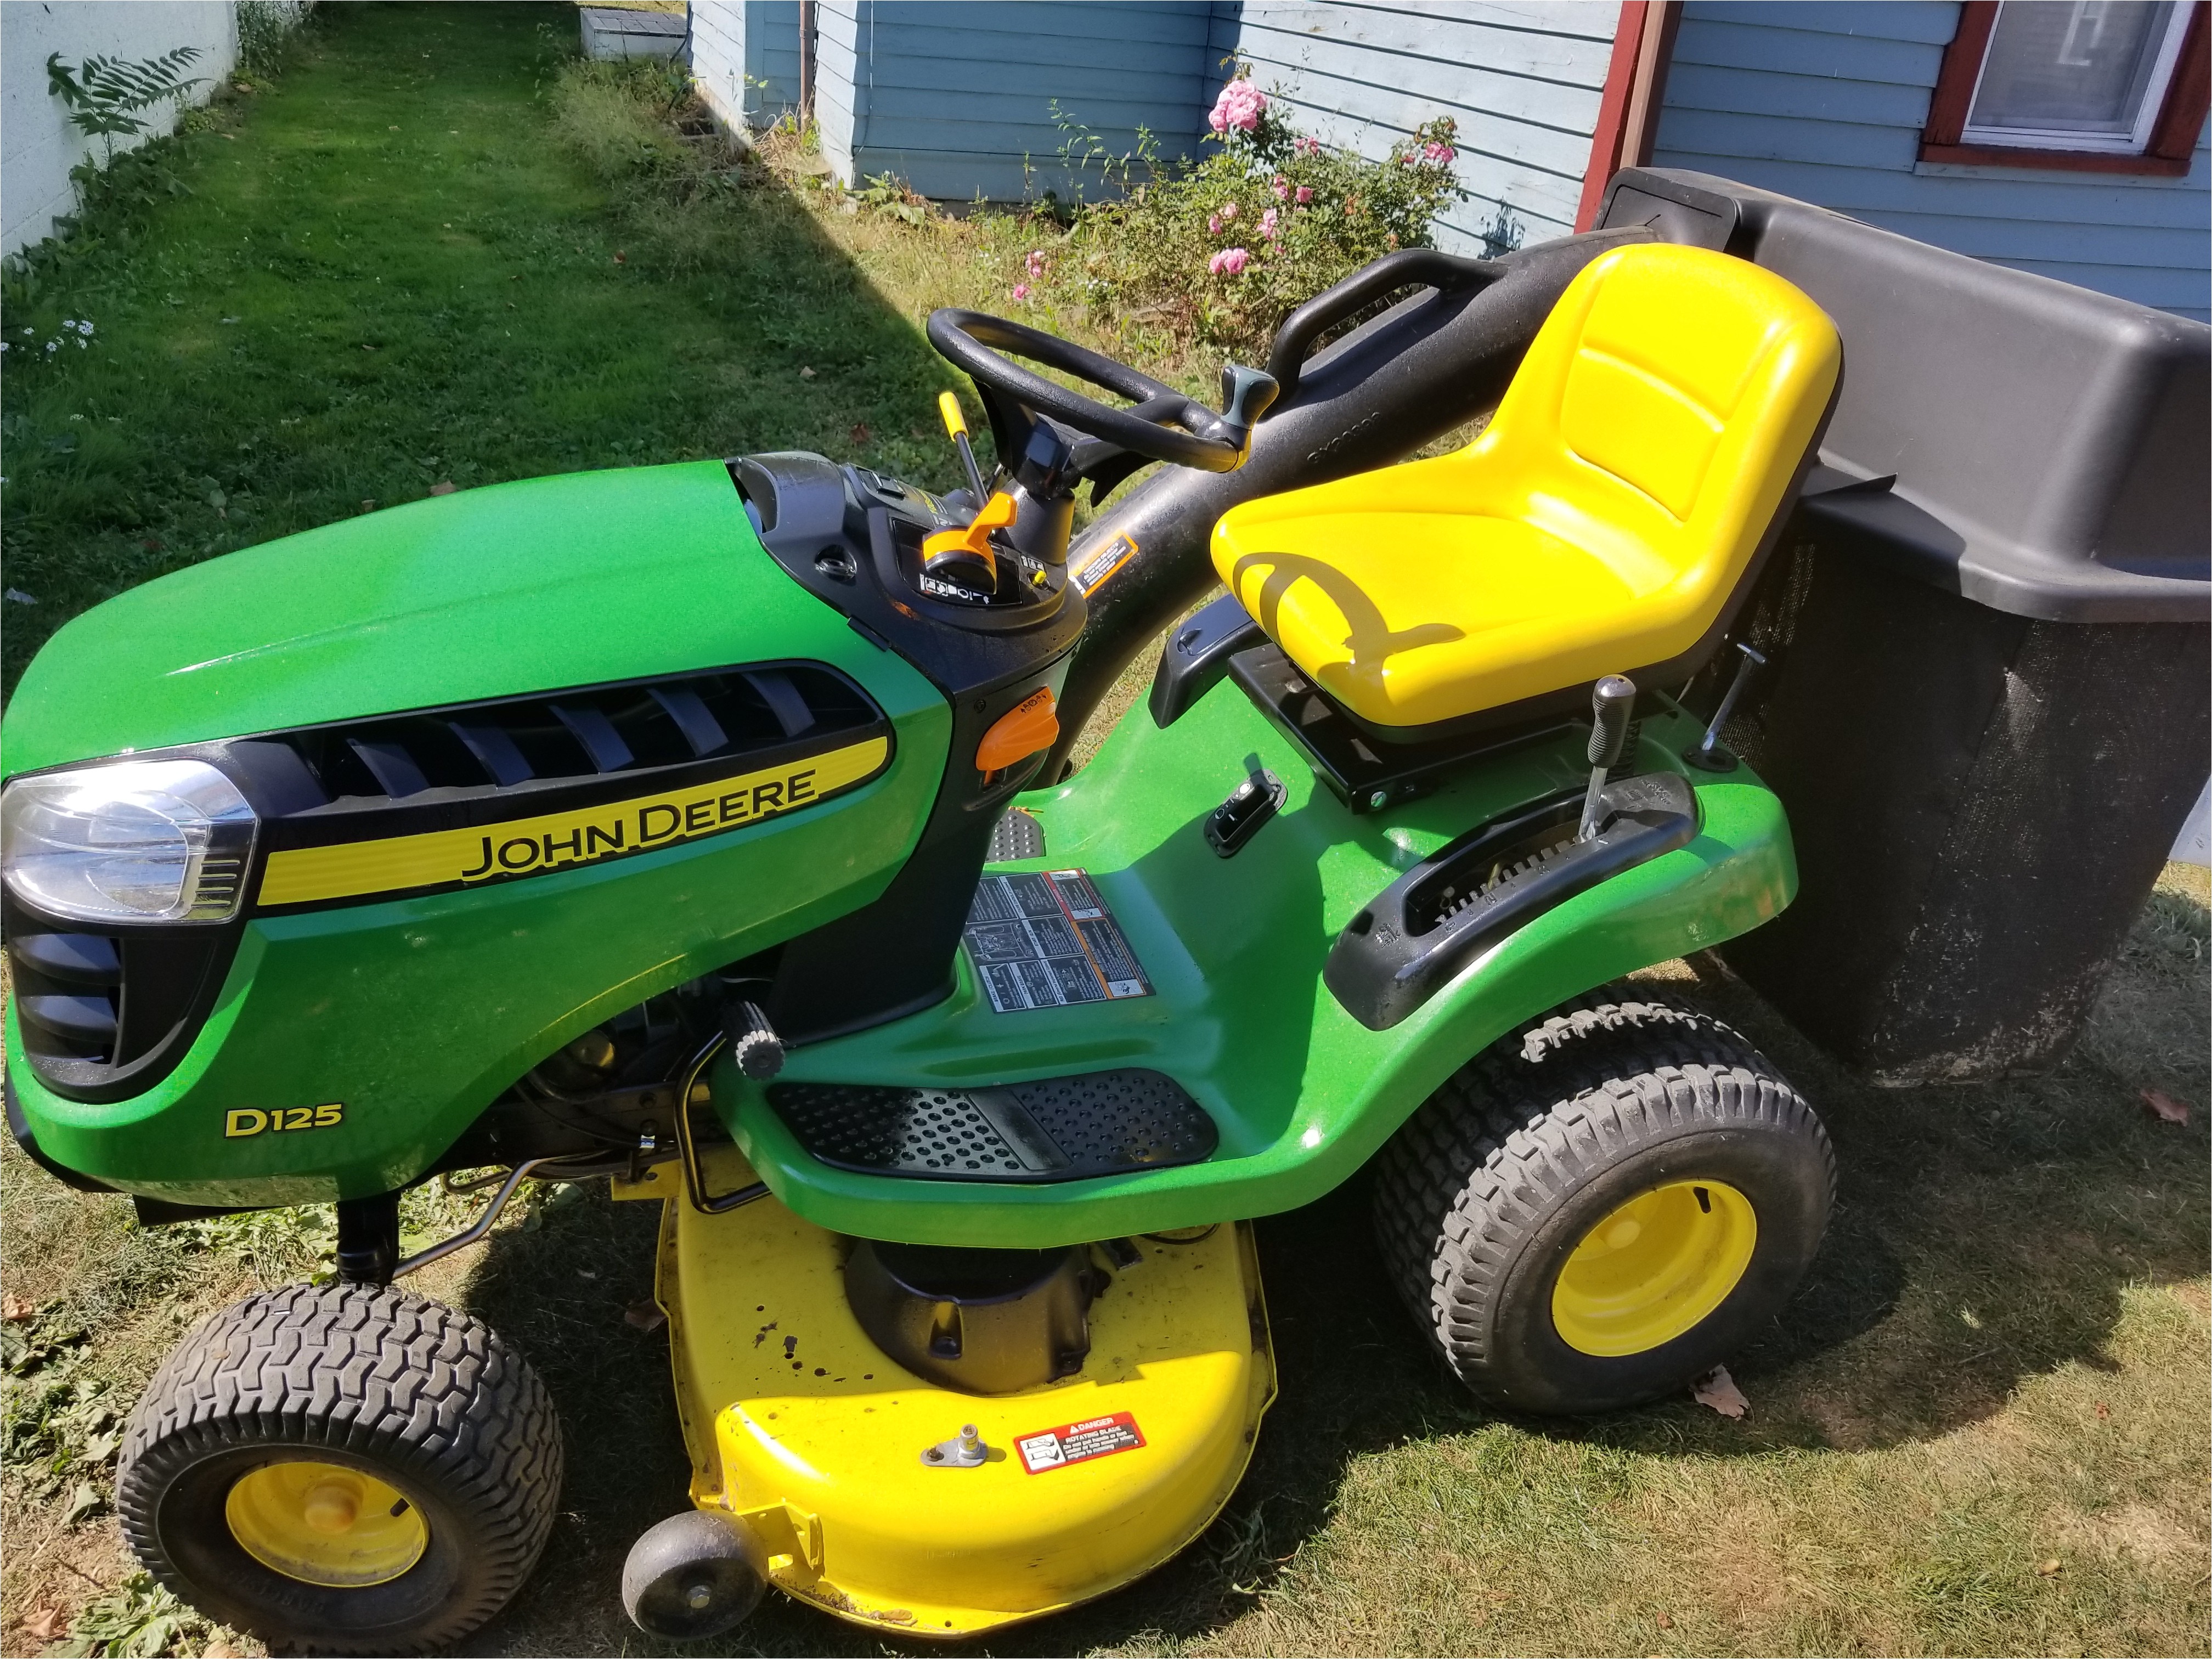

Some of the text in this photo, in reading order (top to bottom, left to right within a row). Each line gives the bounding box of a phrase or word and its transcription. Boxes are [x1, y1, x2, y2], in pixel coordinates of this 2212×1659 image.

[462, 769, 816, 877] JOHN DEERE
[225, 1104, 342, 1137] D125
[1065, 1425, 1121, 1443] ROTATING BLADE
[1077, 1417, 1114, 1430] DANGER
